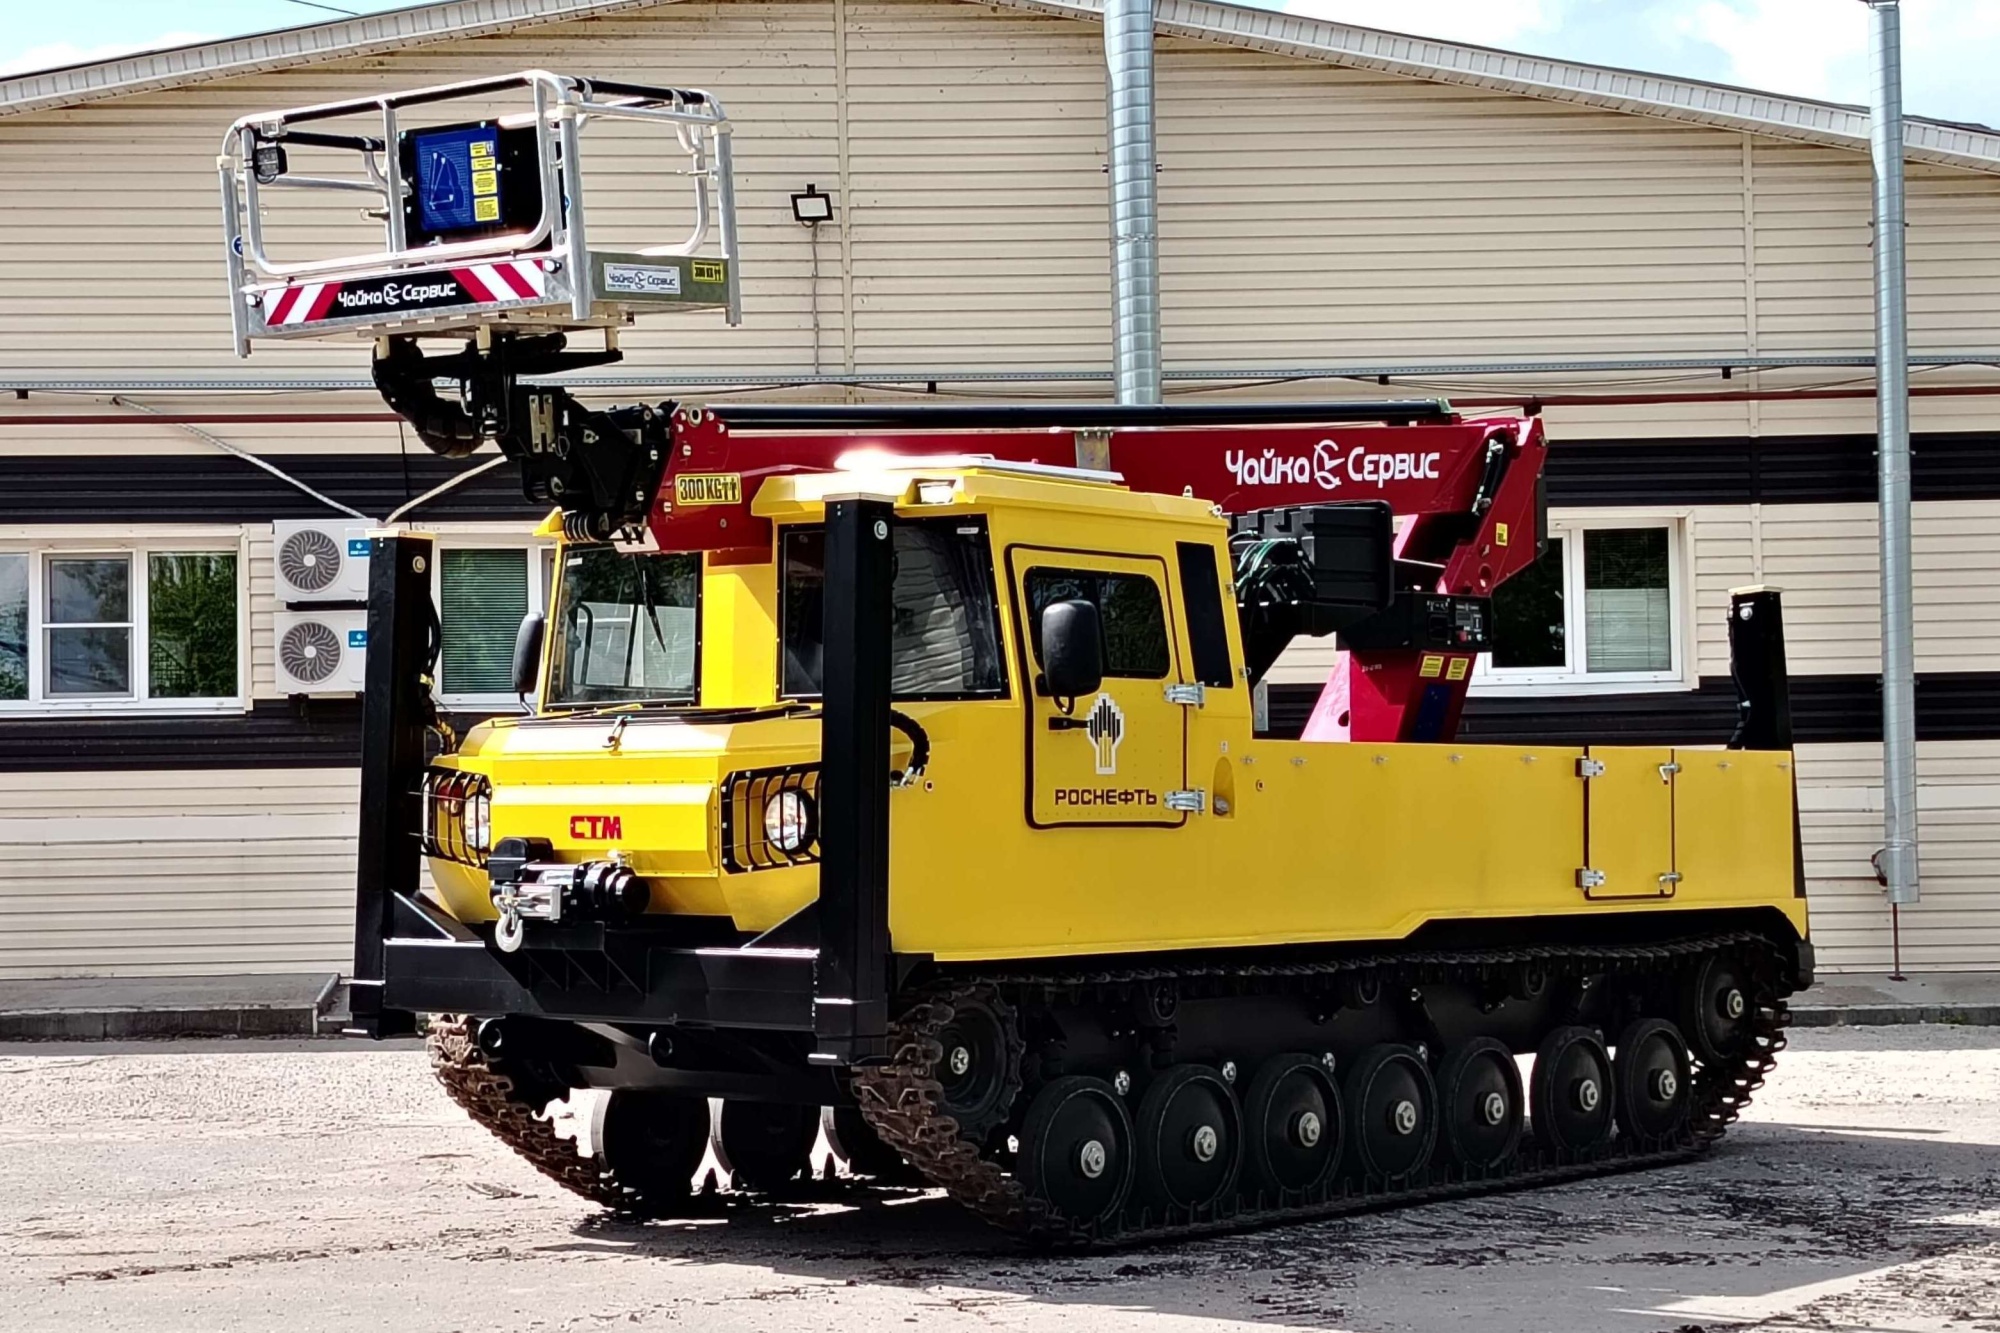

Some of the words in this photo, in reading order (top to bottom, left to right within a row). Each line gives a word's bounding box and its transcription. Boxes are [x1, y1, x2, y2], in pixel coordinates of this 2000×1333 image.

[337, 289, 382, 307] Чайка
[402, 283, 457, 303] Сервис
[1225, 448, 1310, 486] Чайка
[1347, 446, 1441, 488] Сервис
[1055, 788, 1157, 805] РОСНЕФТЬ
[570, 816, 622, 840] СТМ
